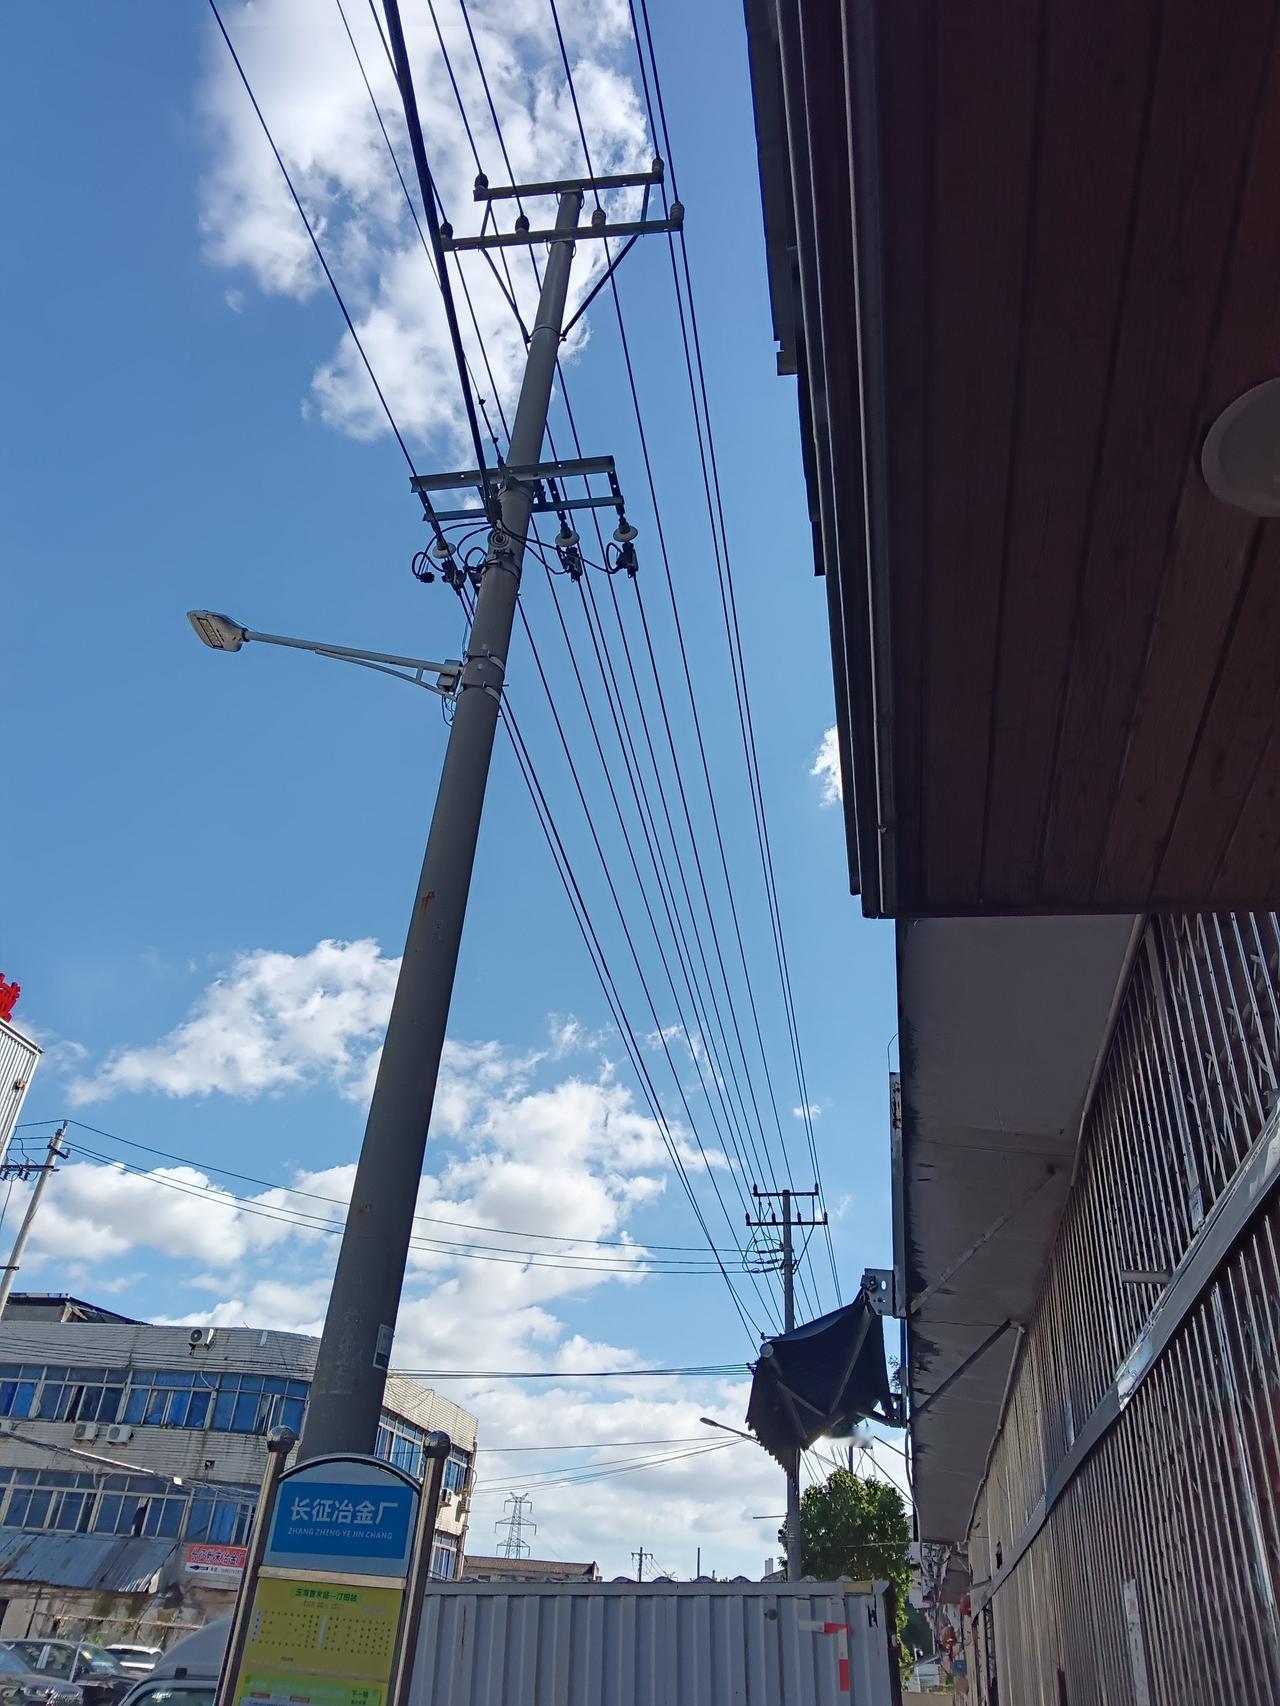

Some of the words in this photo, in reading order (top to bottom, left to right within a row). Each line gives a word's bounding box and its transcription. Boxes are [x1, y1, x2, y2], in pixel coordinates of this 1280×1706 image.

[290, 1497, 399, 1525] 长征冶金厂
[288, 1527, 314, 1536] ZHANG
[315, 1528, 341, 1537] ZHENG
[365, 1531, 393, 1540] CHANG
